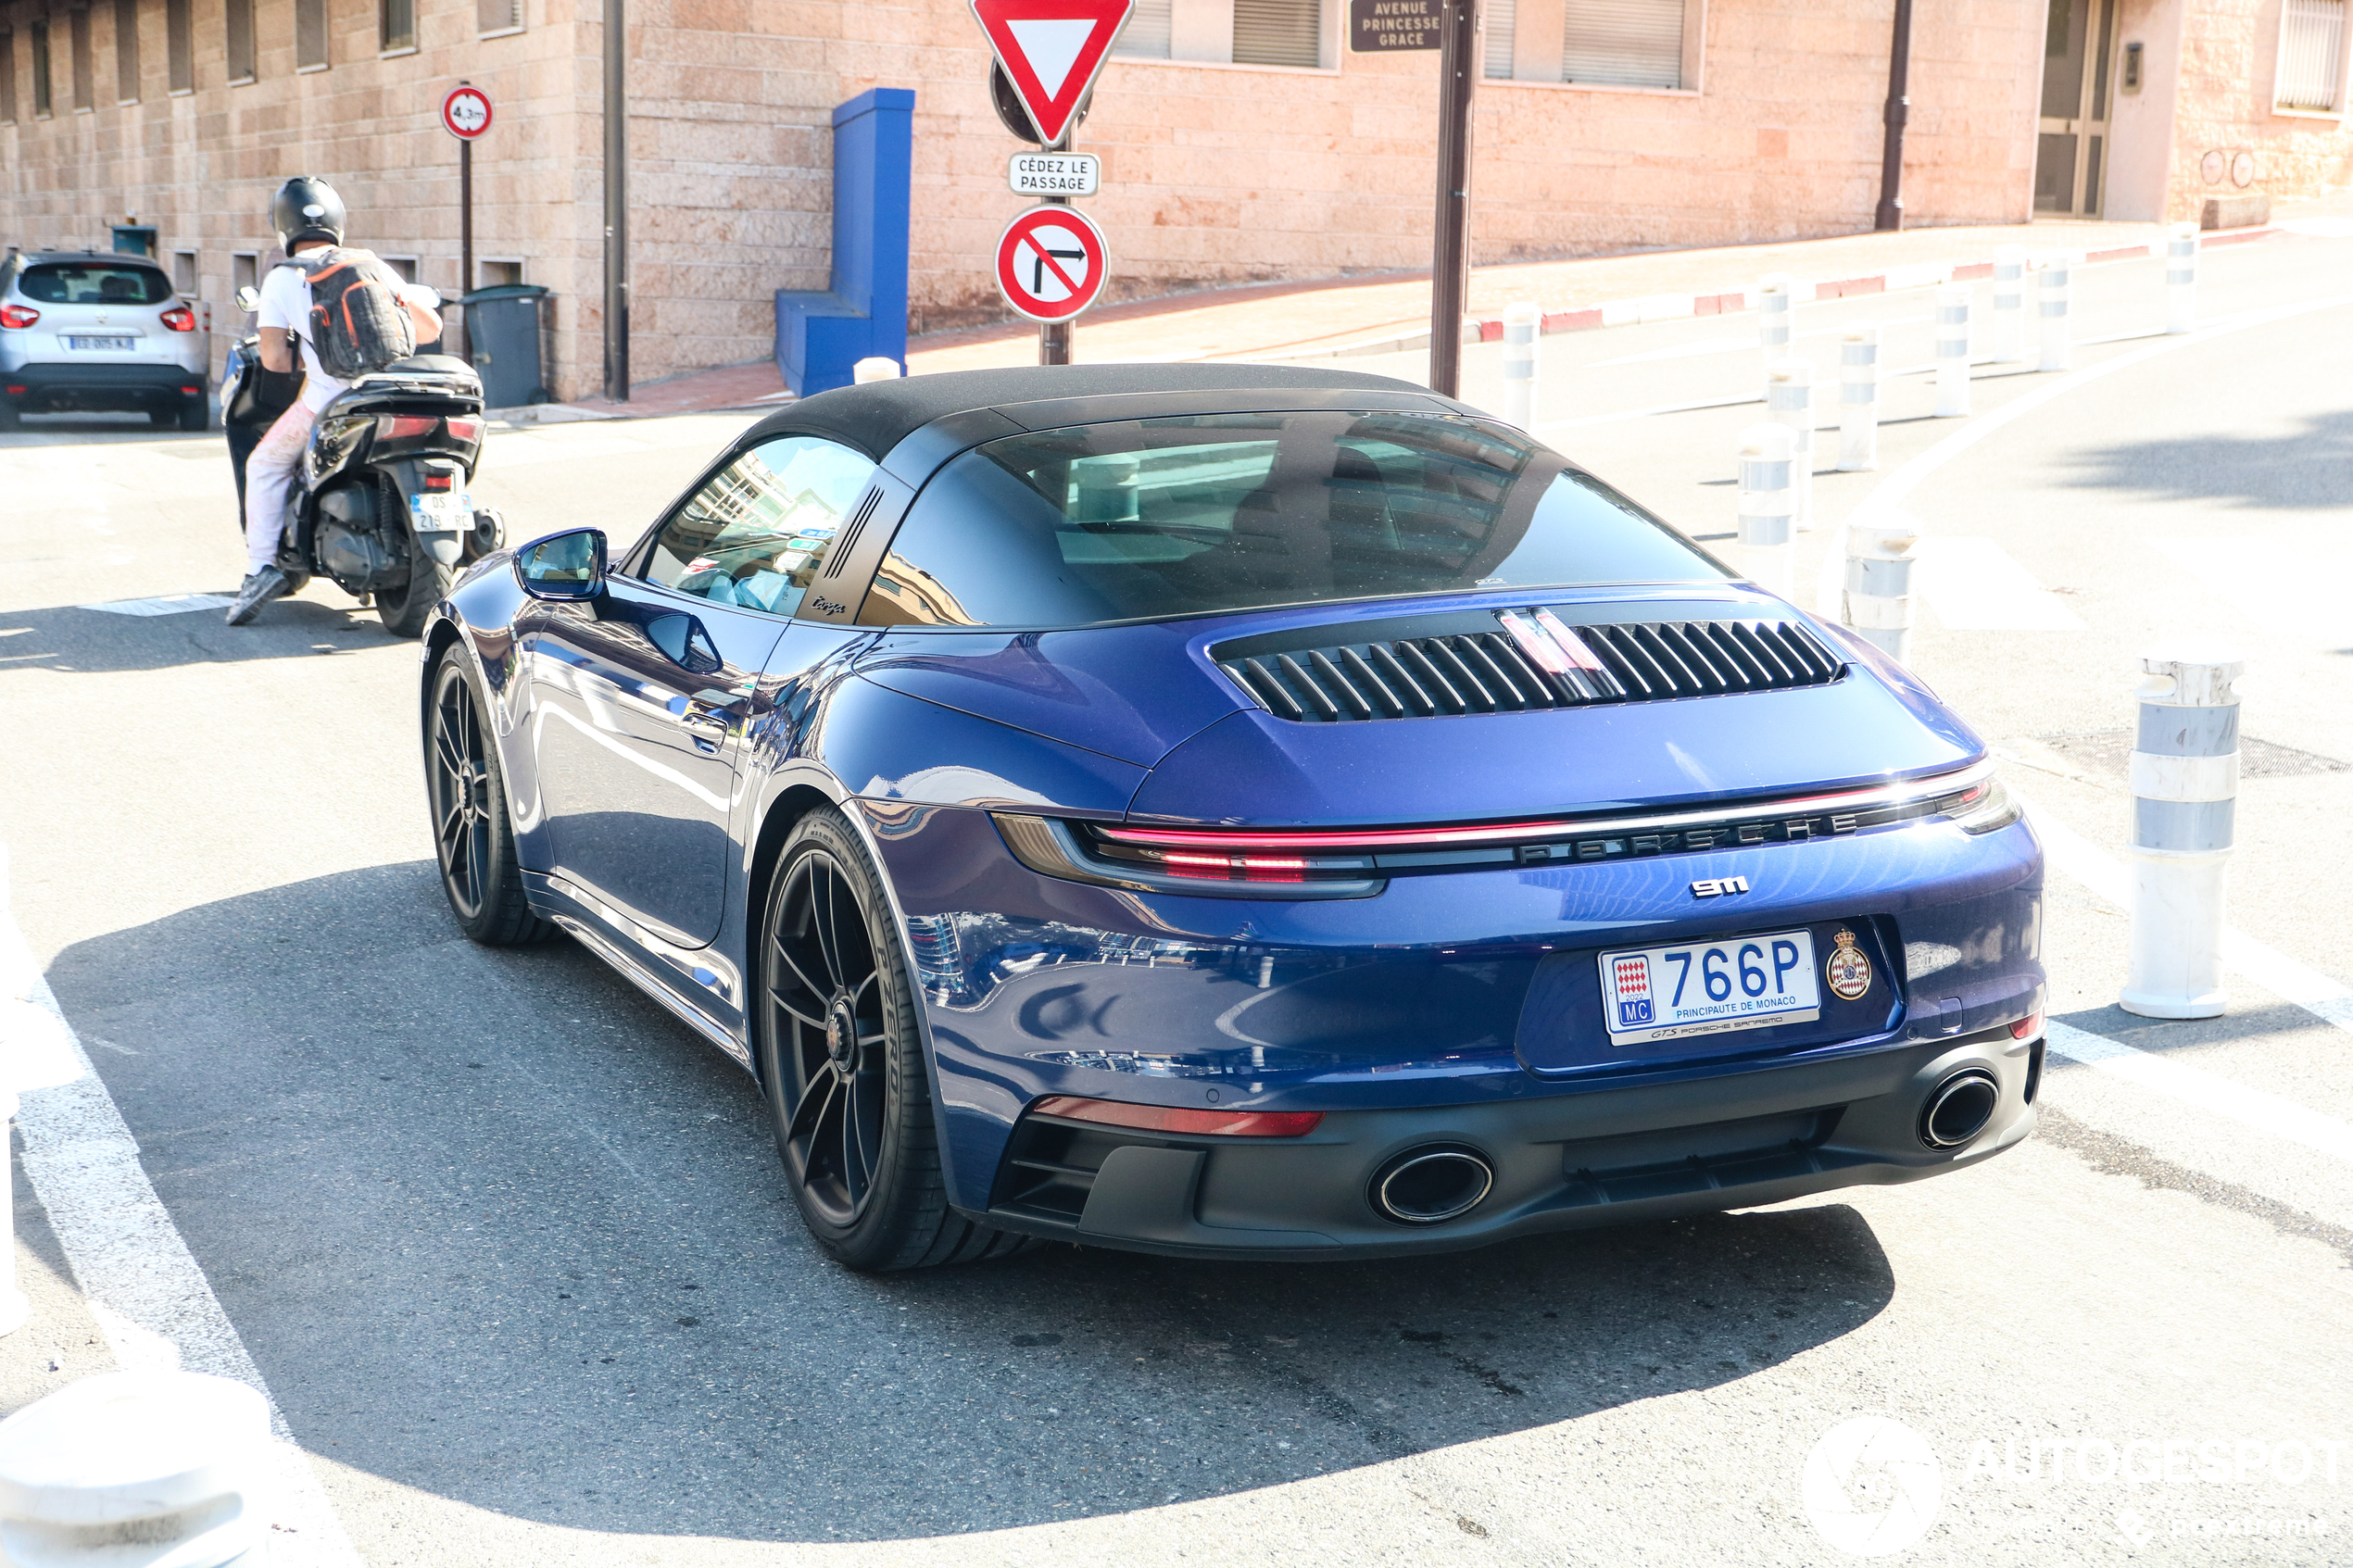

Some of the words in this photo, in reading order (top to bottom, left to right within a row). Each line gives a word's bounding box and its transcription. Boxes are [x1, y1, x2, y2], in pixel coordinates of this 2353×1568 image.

[1375, 1, 1428, 15] AVENUE
[1362, 17, 1440, 31] PRINCESSE
[1378, 31, 1425, 46] GRACE
[1019, 157, 1064, 173] CÉDEZ
[1072, 161, 1088, 174] LE
[1021, 176, 1085, 190] PASSAGE
[1519, 813, 1857, 865] PORSCHE
[1690, 875, 1750, 899] 911
[1664, 940, 1799, 1008] 766P
[1625, 993, 1644, 1001] 2022
[1626, 1002, 1648, 1022] MC
[1676, 1003, 1738, 1020] PRINCIPAUTE
[1740, 1001, 1753, 1010] DE
[1755, 996, 1796, 1009] MONACO
[883, 979, 899, 1094] ZERO
[1651, 1028, 1678, 1038] GTS
[1680, 1022, 1730, 1035] PORSCHE
[1733, 1016, 1783, 1028] SANREMO
